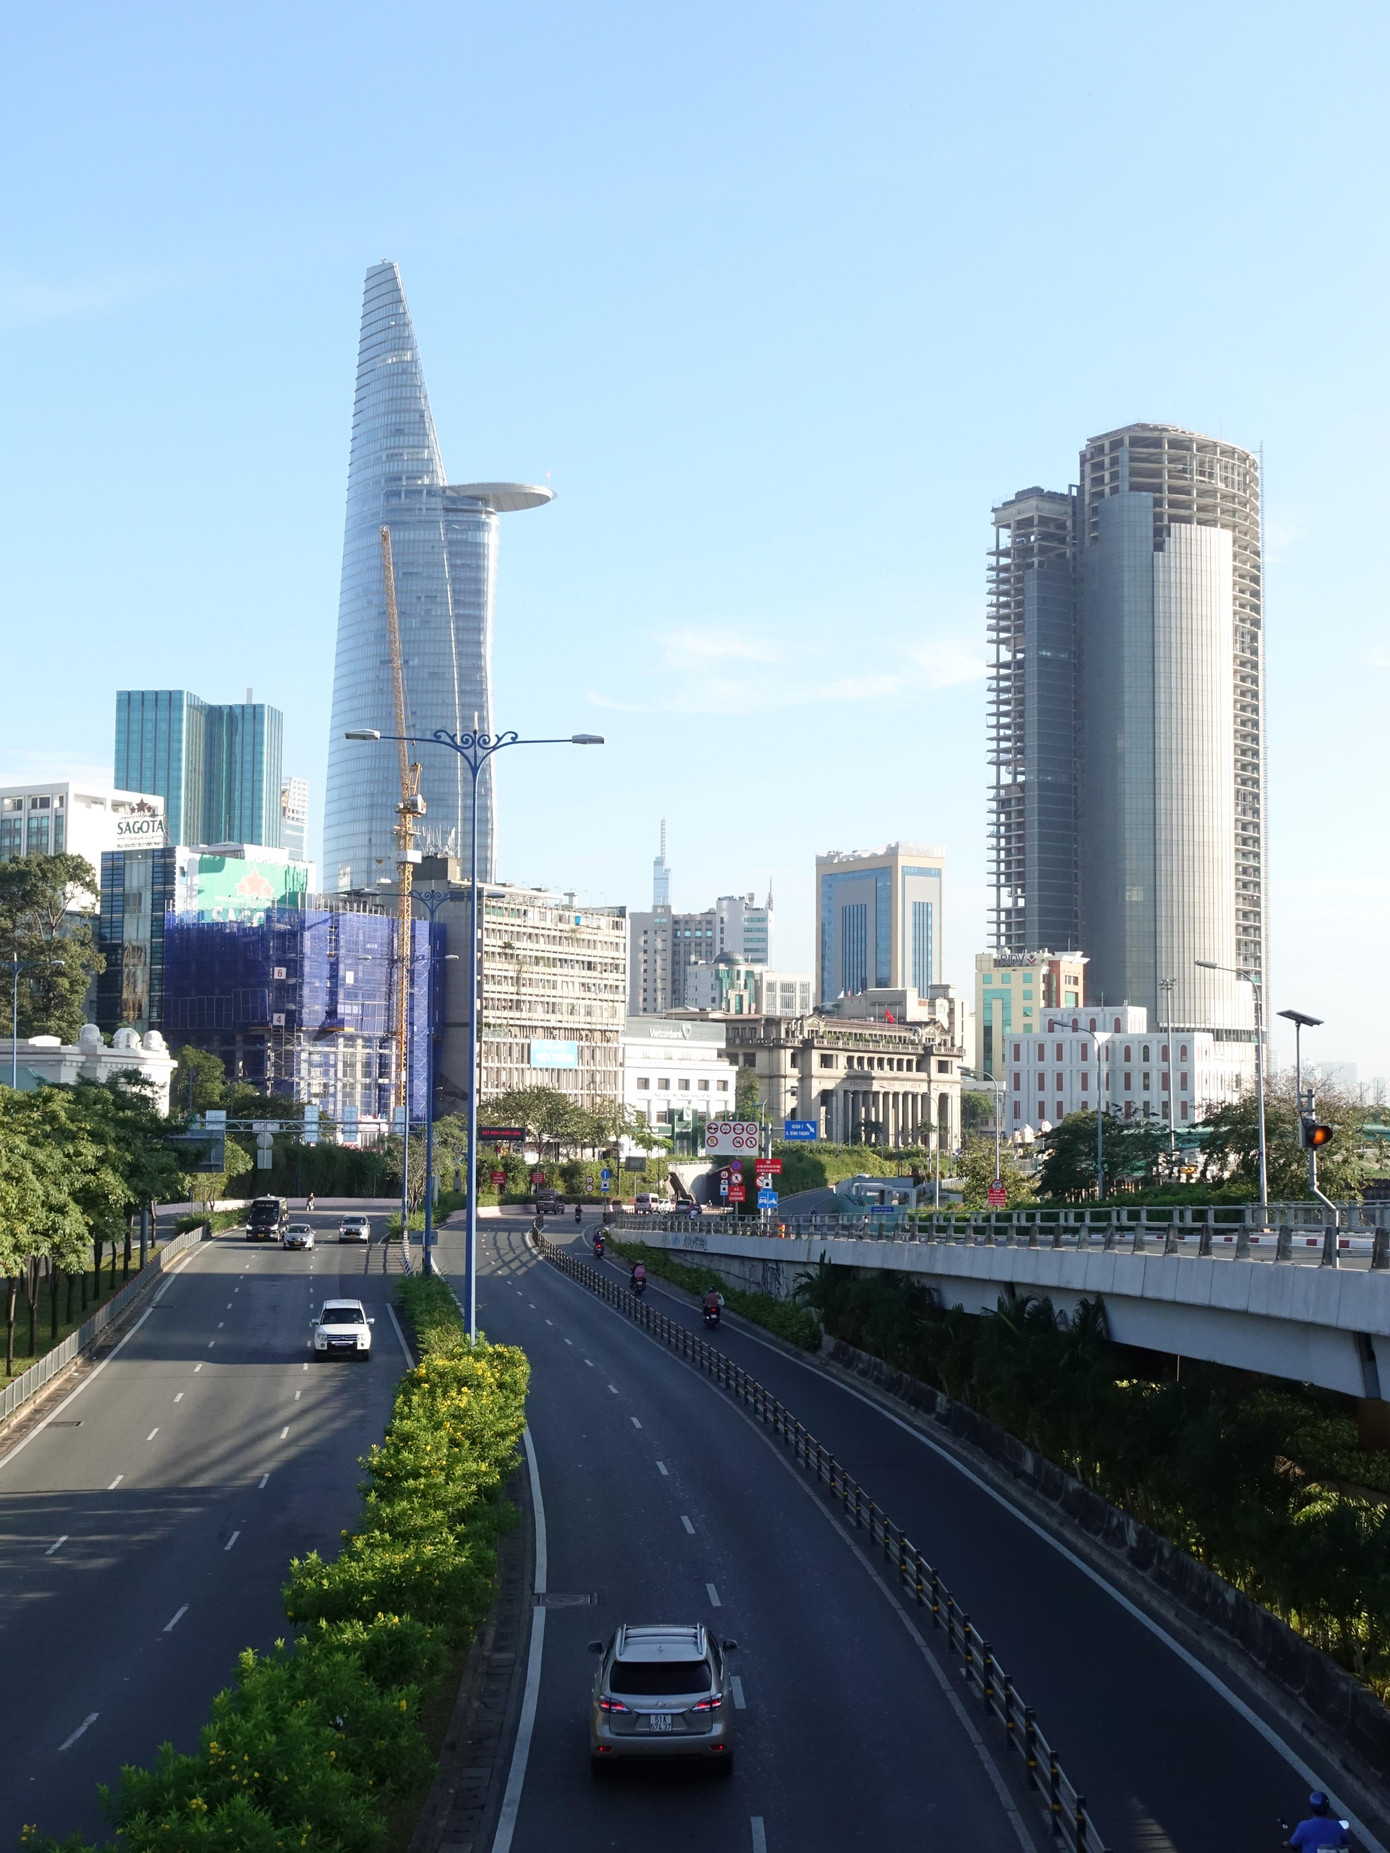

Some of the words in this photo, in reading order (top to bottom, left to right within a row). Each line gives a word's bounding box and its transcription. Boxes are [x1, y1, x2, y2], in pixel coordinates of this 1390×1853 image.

[117, 819, 164, 835] SAGOTA
[277, 968, 283, 978] 6
[276, 1015, 281, 1024] 4
[649, 1028, 683, 1039] Vietcombank
